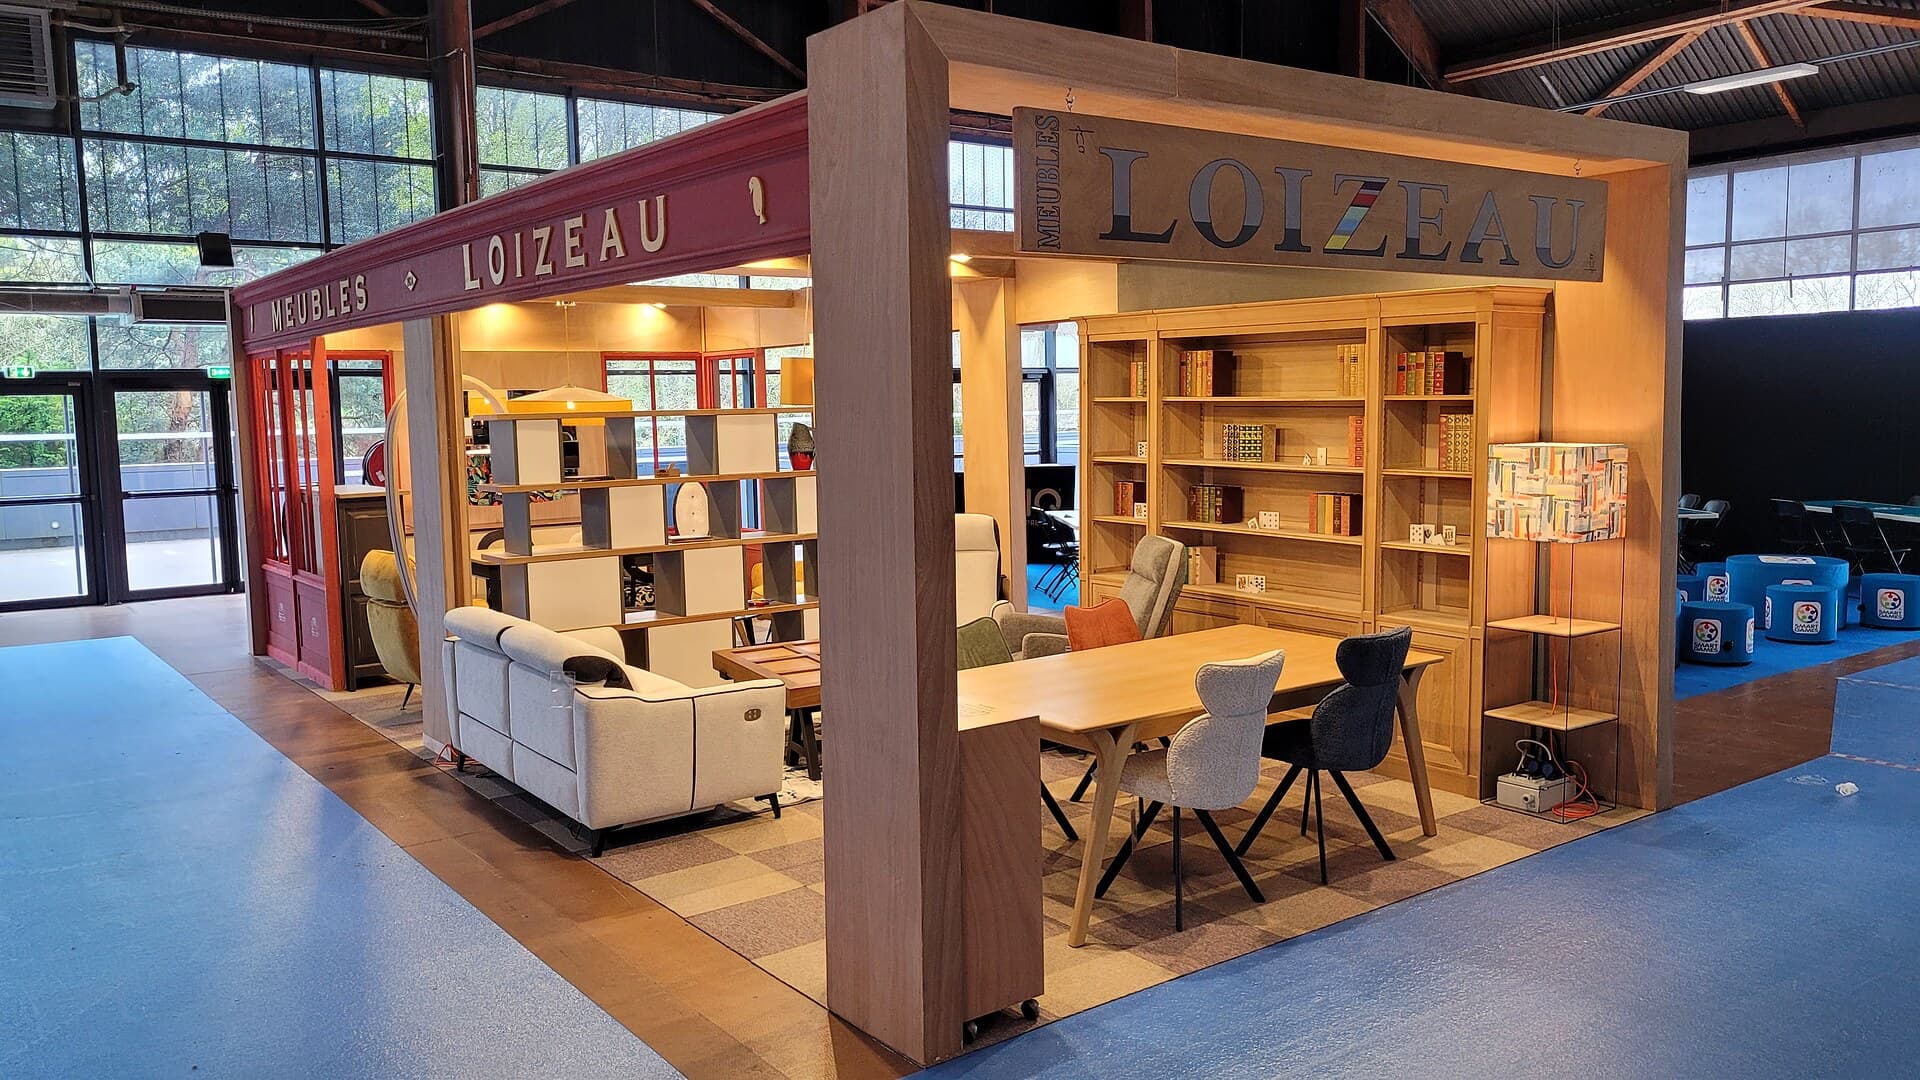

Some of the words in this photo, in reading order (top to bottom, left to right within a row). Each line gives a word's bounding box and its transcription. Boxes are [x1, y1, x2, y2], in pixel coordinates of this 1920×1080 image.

[1035, 115, 1061, 249] MEUBLES
[1099, 146, 1584, 269] LOIZEAU
[271, 274, 368, 332] MEUBLES
[462, 195, 667, 291] LOIZEAU
